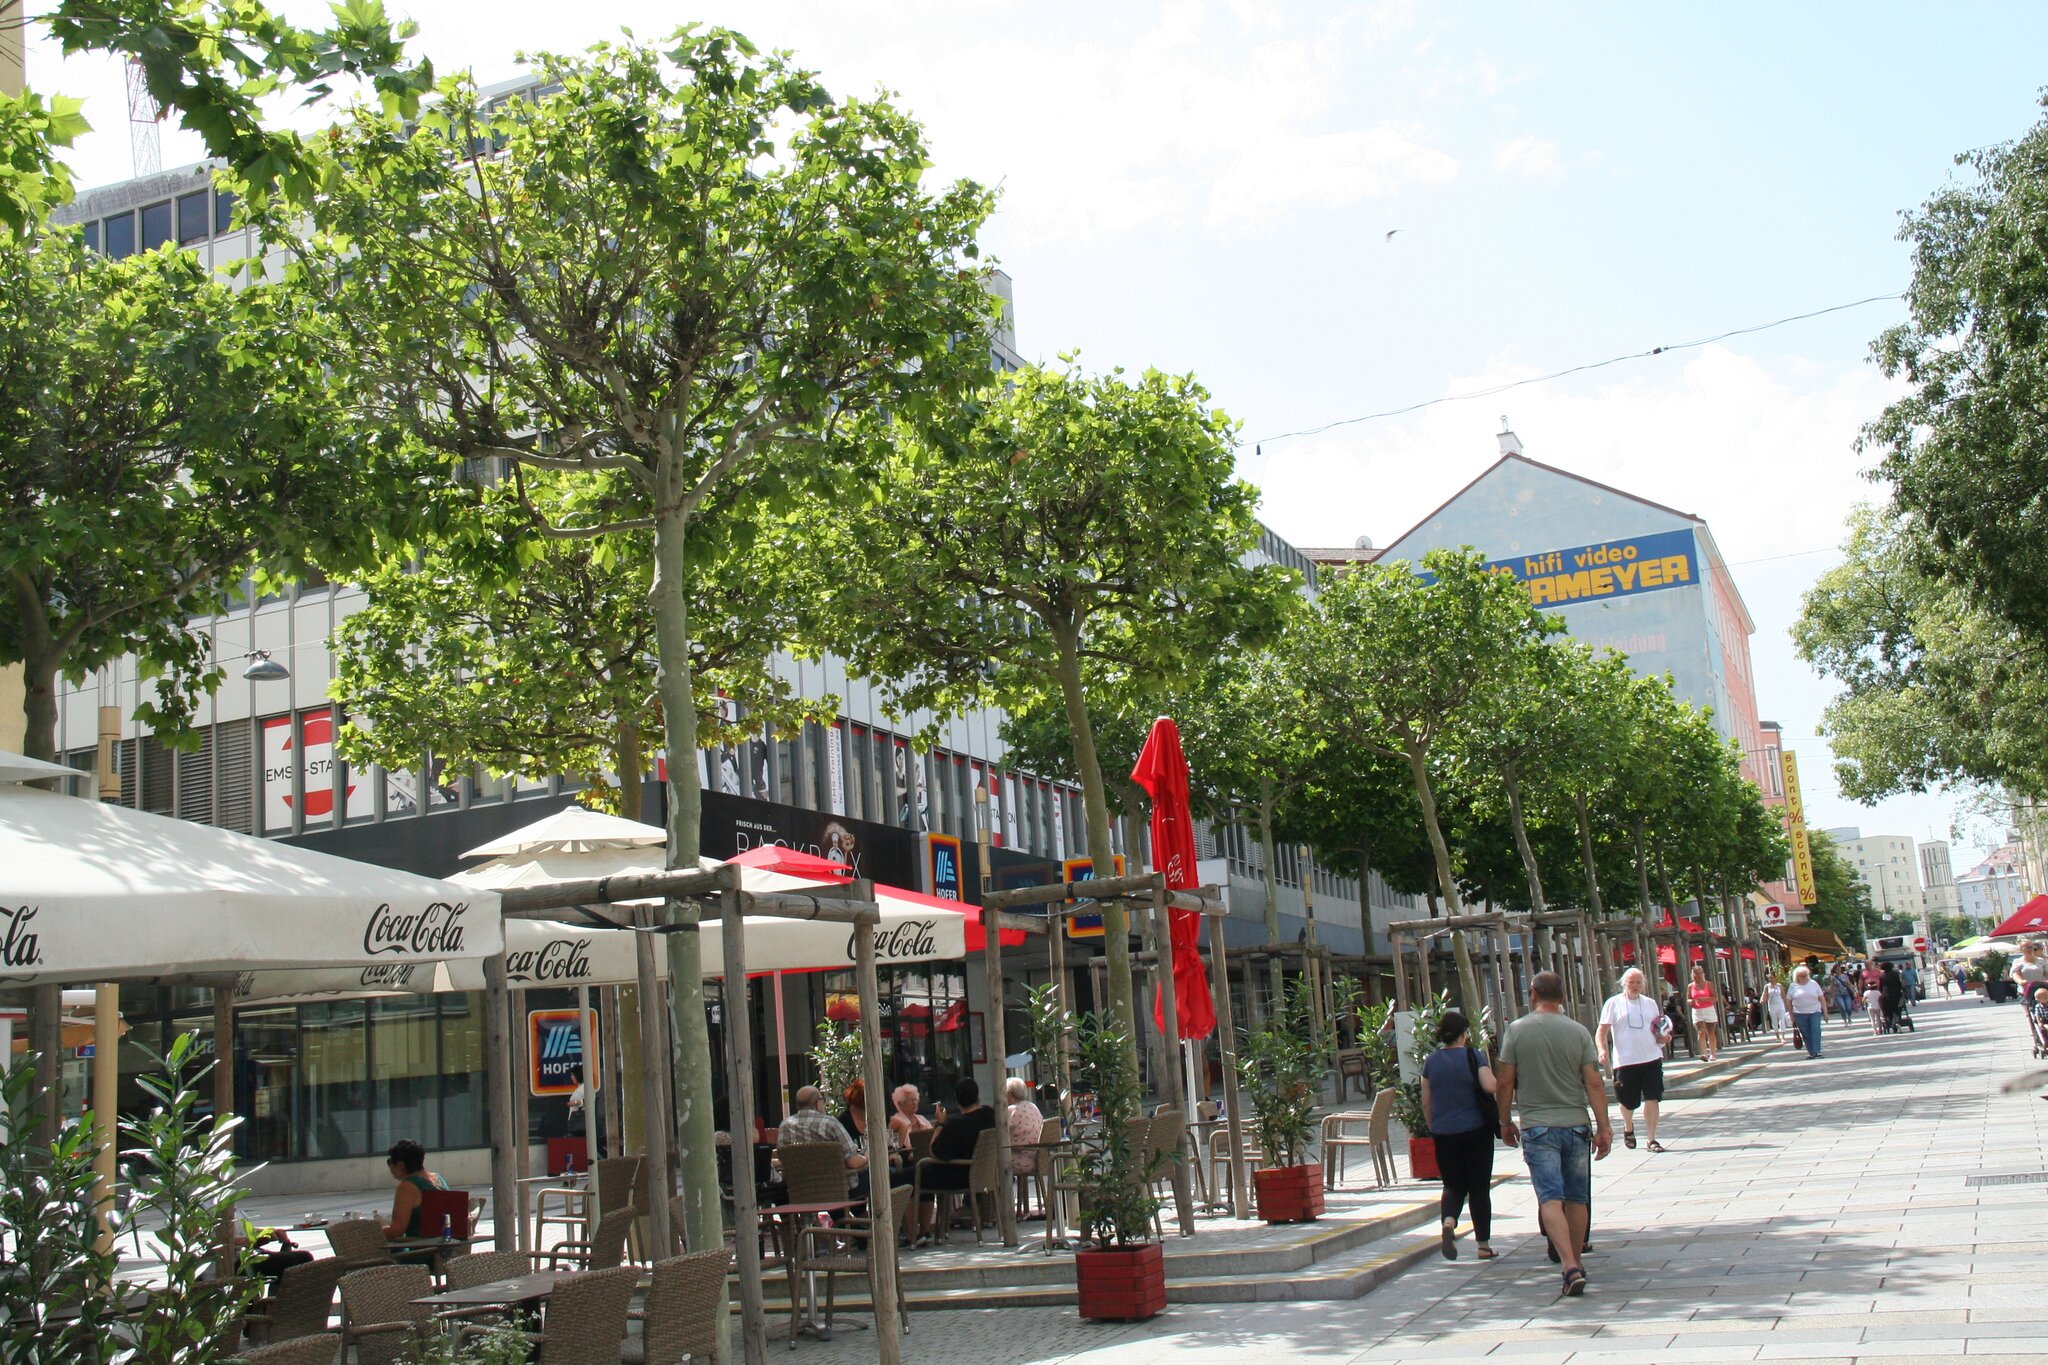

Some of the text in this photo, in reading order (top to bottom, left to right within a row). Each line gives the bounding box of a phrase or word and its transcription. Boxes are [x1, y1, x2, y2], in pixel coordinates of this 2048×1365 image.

[1525, 551, 1562, 577] hifi
[1575, 544, 1637, 568] video
[1515, 554, 1690, 606] RMEYER
[736, 819, 753, 829] FRISCH
[936, 887, 958, 902] HOFER
[364, 902, 470, 955] Coca-Cola
[543, 1062, 583, 1075] HOF
